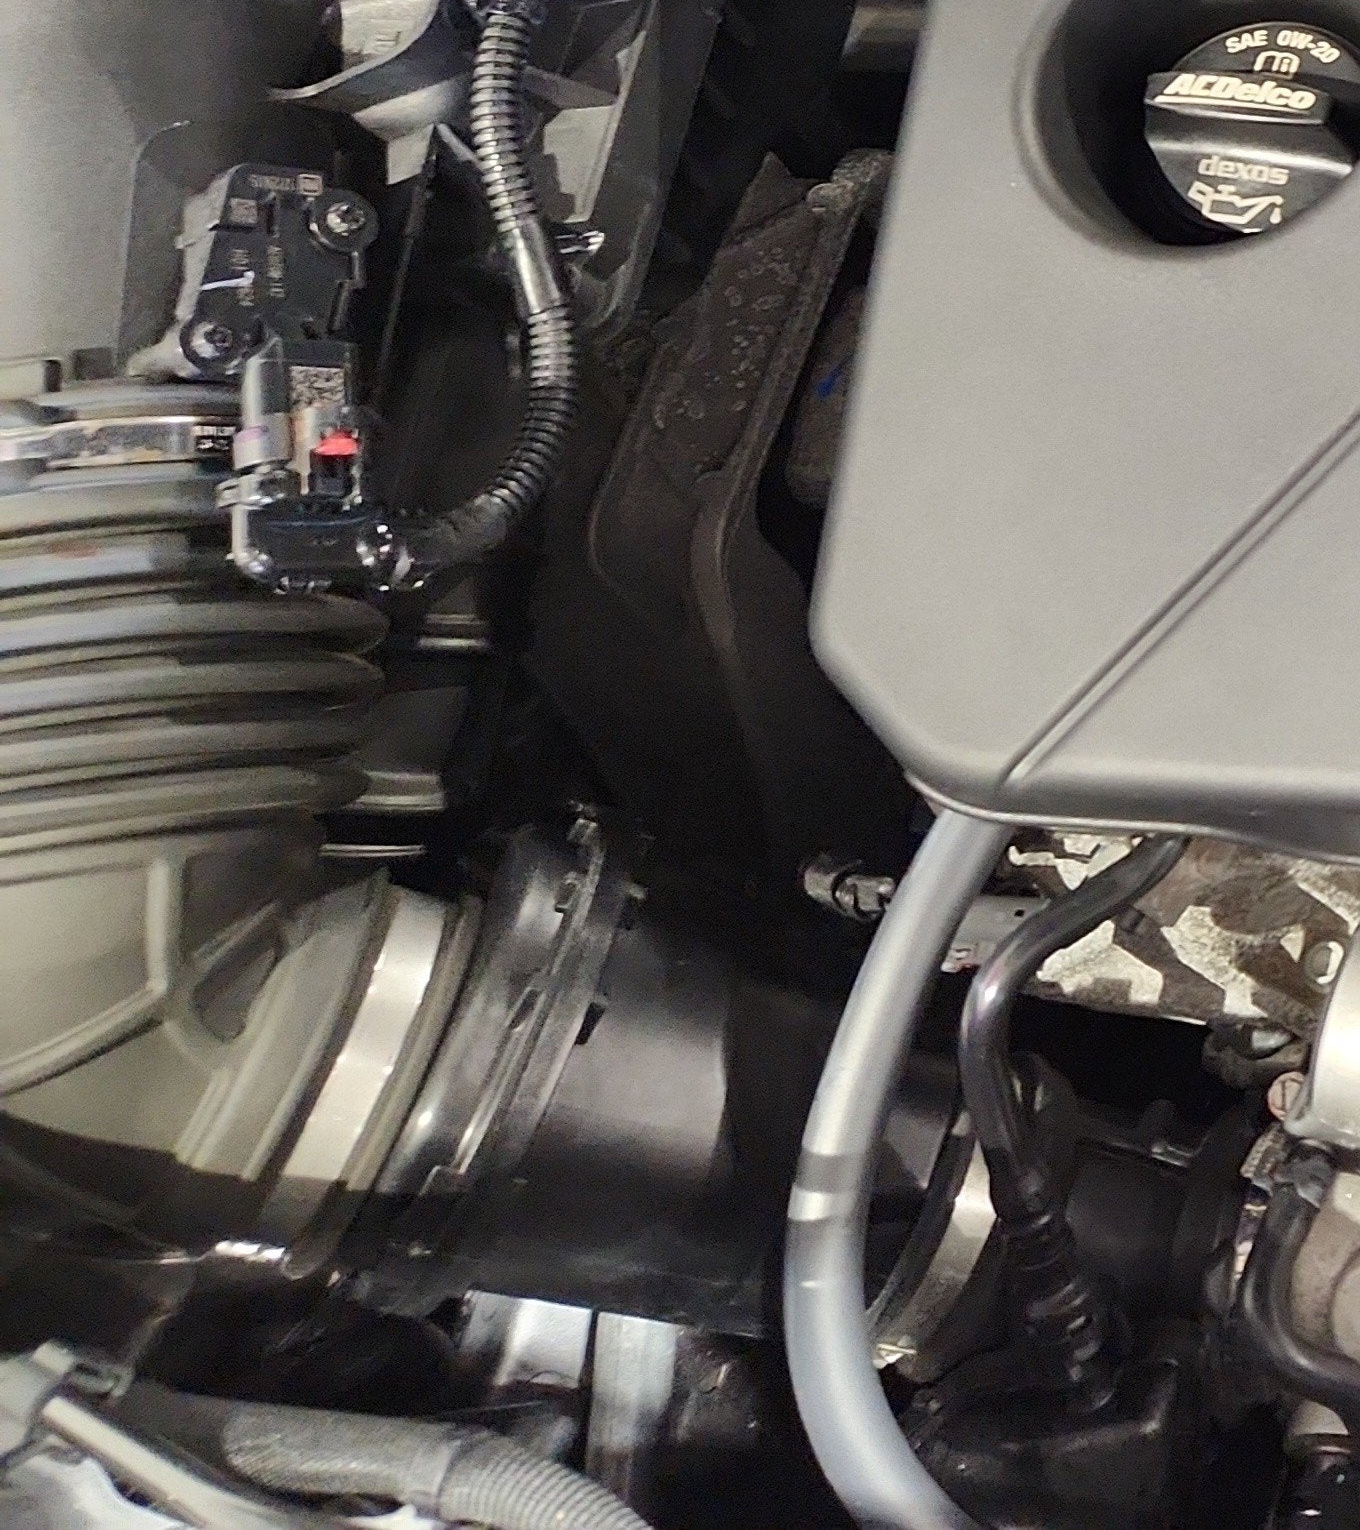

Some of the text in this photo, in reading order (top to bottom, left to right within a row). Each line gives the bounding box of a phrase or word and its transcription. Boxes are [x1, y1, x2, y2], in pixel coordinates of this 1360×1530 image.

[1225, 30, 1341, 64] SAE 0W-20
[1164, 73, 1316, 110] ACDelco
[1198, 155, 1290, 186] dexos
